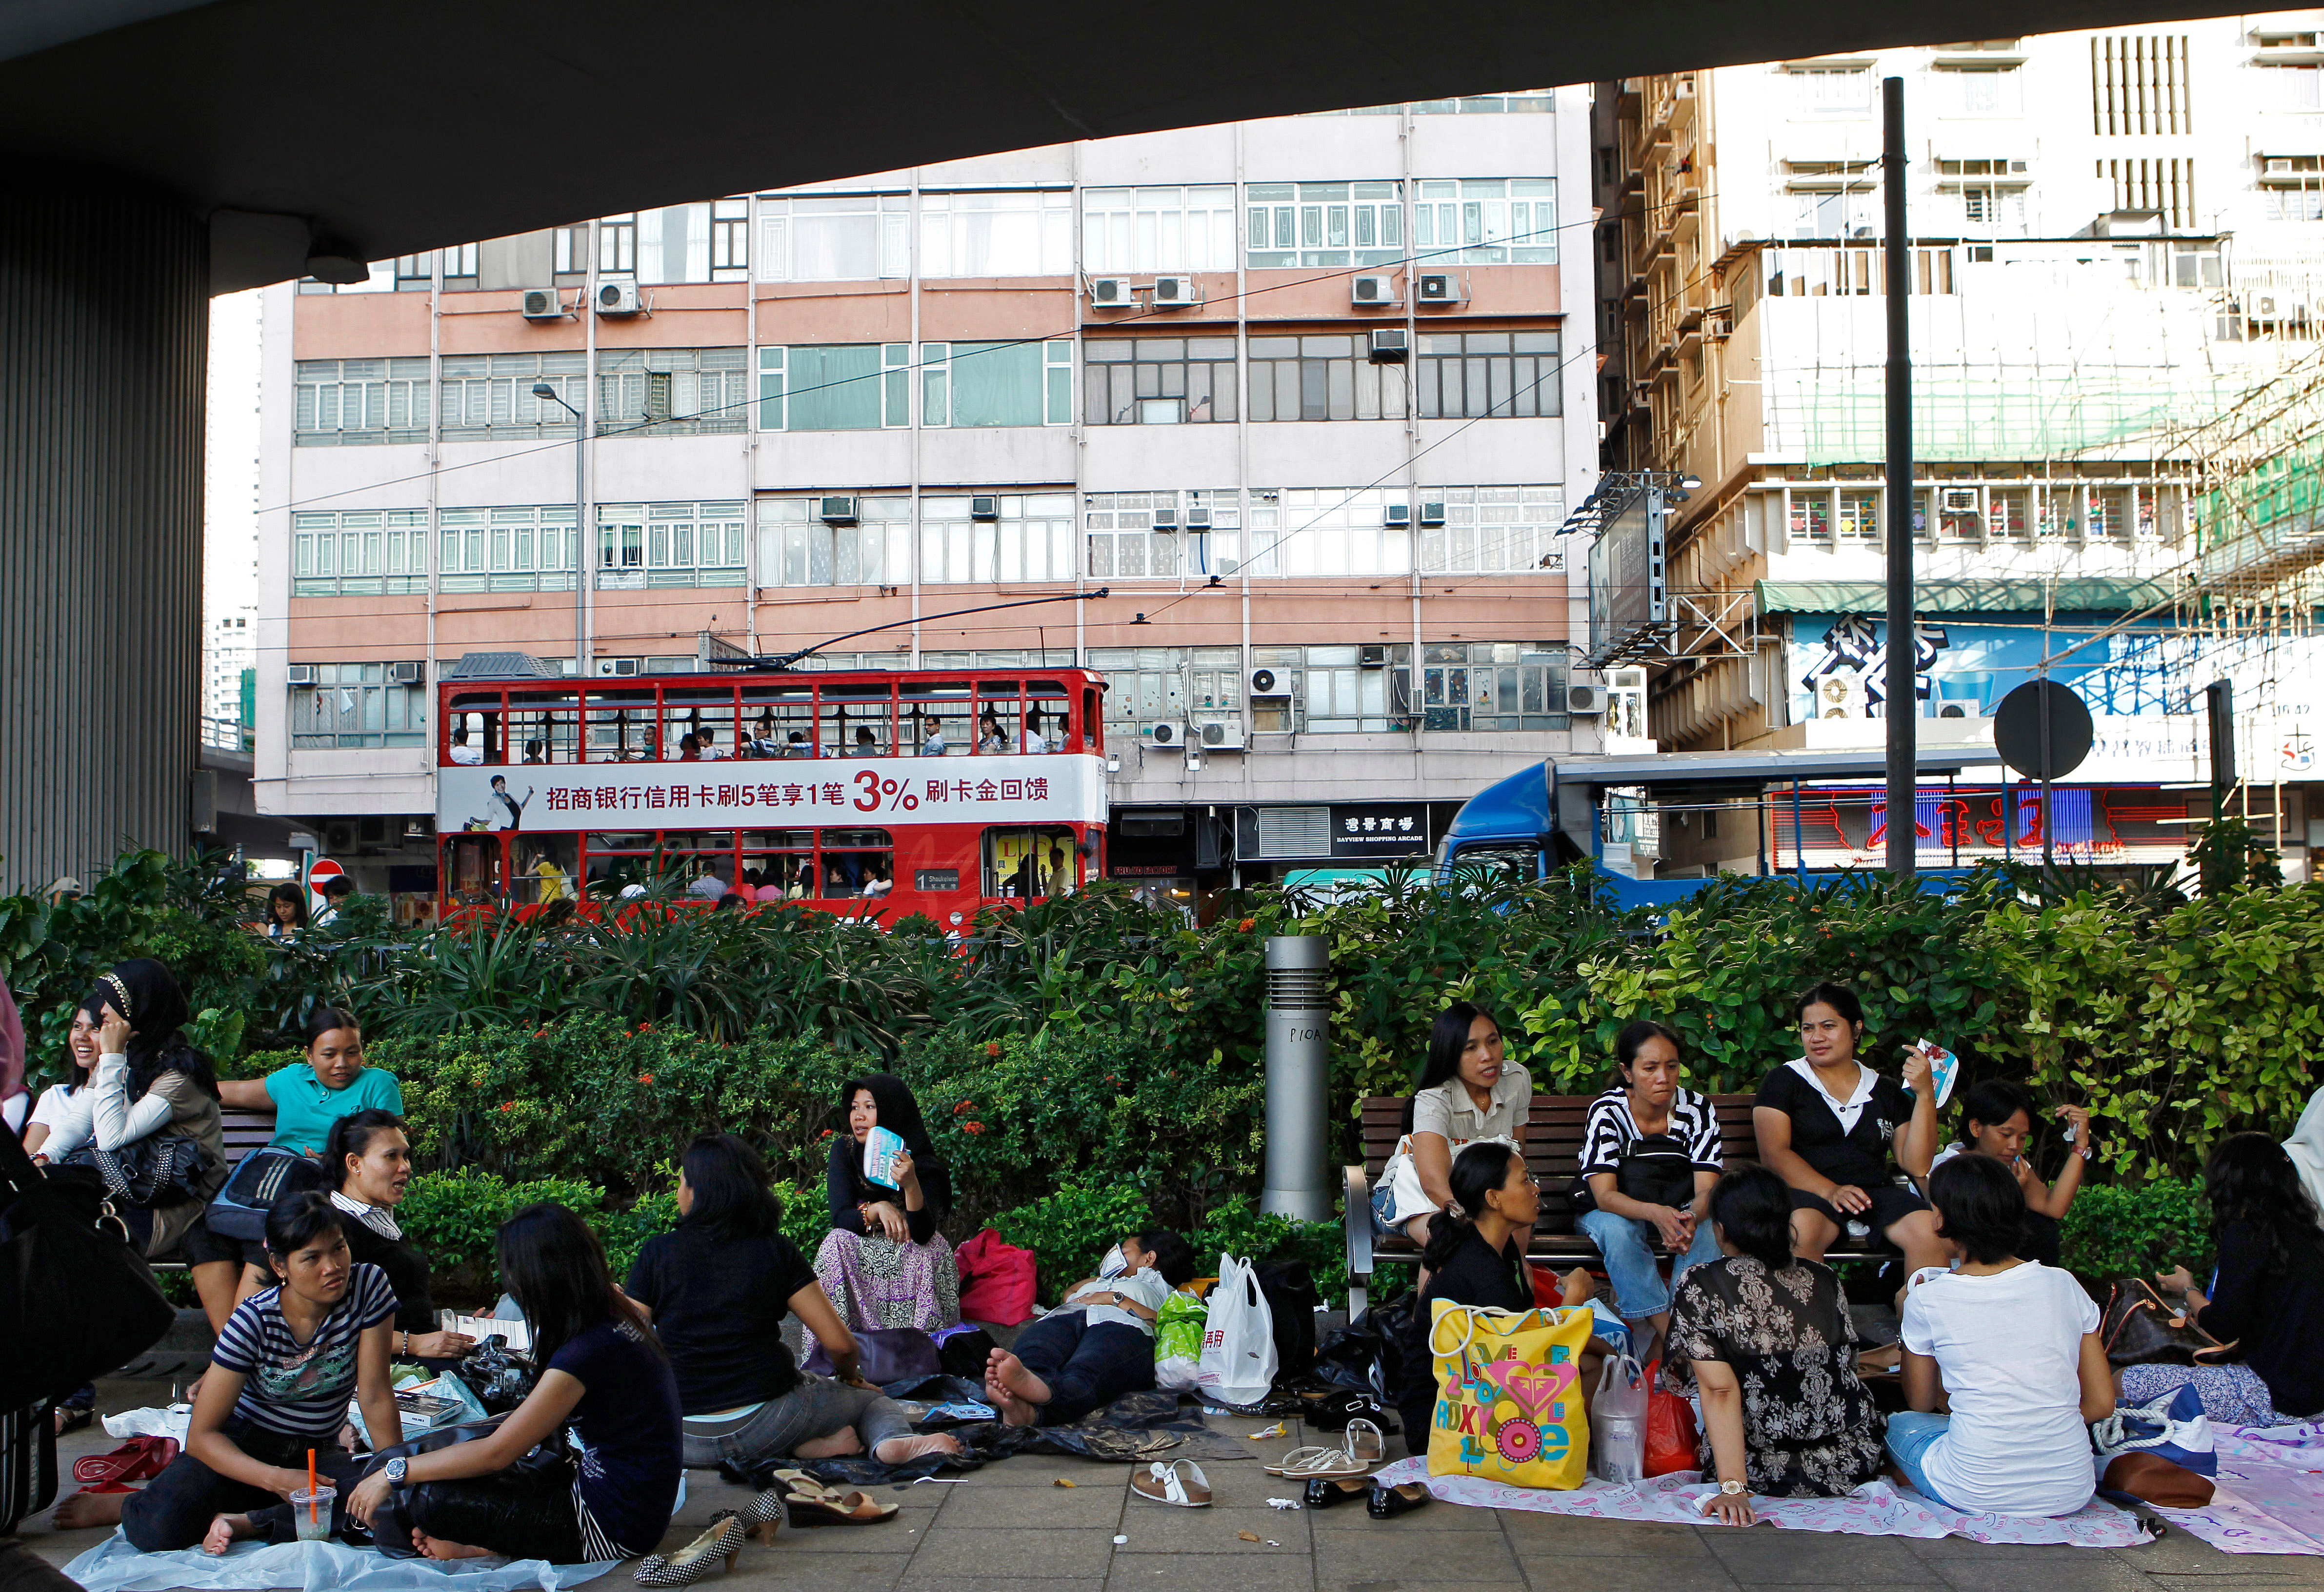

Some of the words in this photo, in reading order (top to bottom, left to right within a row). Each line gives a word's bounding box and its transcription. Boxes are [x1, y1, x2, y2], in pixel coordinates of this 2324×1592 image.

[546, 781, 845, 810] 招商银行信用卡刷5笔享1笔
[853, 770, 919, 812] 3%
[925, 777, 1048, 802] 刷卡金回馈
[1345, 817, 1414, 832] 灣景商場
[1143, 866, 1177, 874] FACTORY
[917, 874, 924, 890] 1
[1436, 1399, 1493, 1436] ROXY
